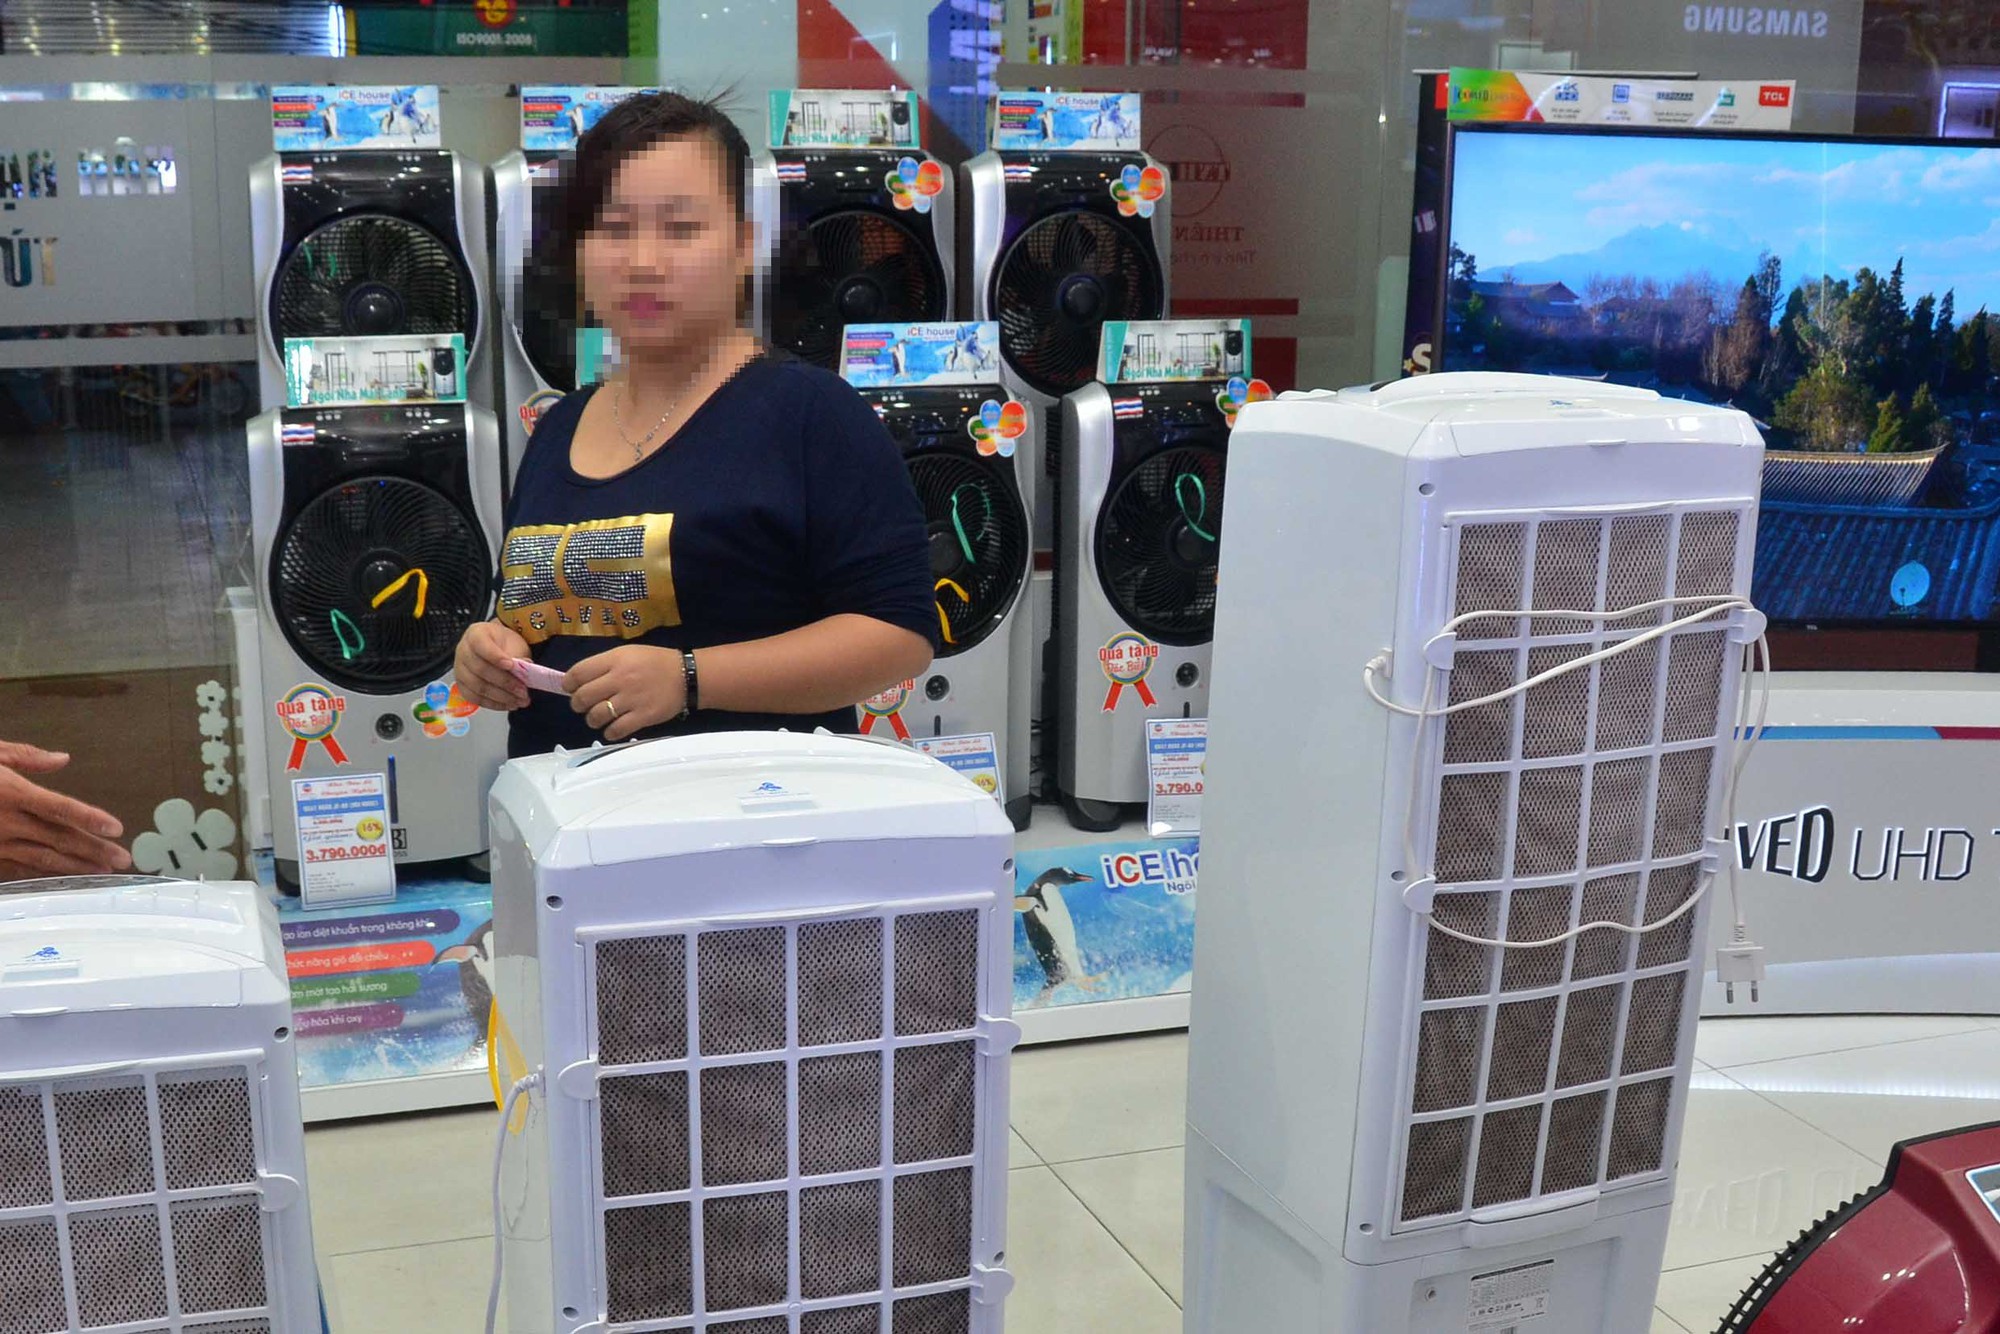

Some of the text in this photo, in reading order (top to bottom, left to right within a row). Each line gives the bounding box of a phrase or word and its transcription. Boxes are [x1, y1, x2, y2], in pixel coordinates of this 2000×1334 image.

[1762, 91, 1785, 101] TCL
[926, 326, 955, 336] house
[362, 822, 380, 833] 16%
[1725, 805, 1975, 883] VED UHD
[306, 843, 386, 862] 3.790.000đ
[1104, 853, 1165, 886] iCE
[346, 1012, 363, 1026] oxy
